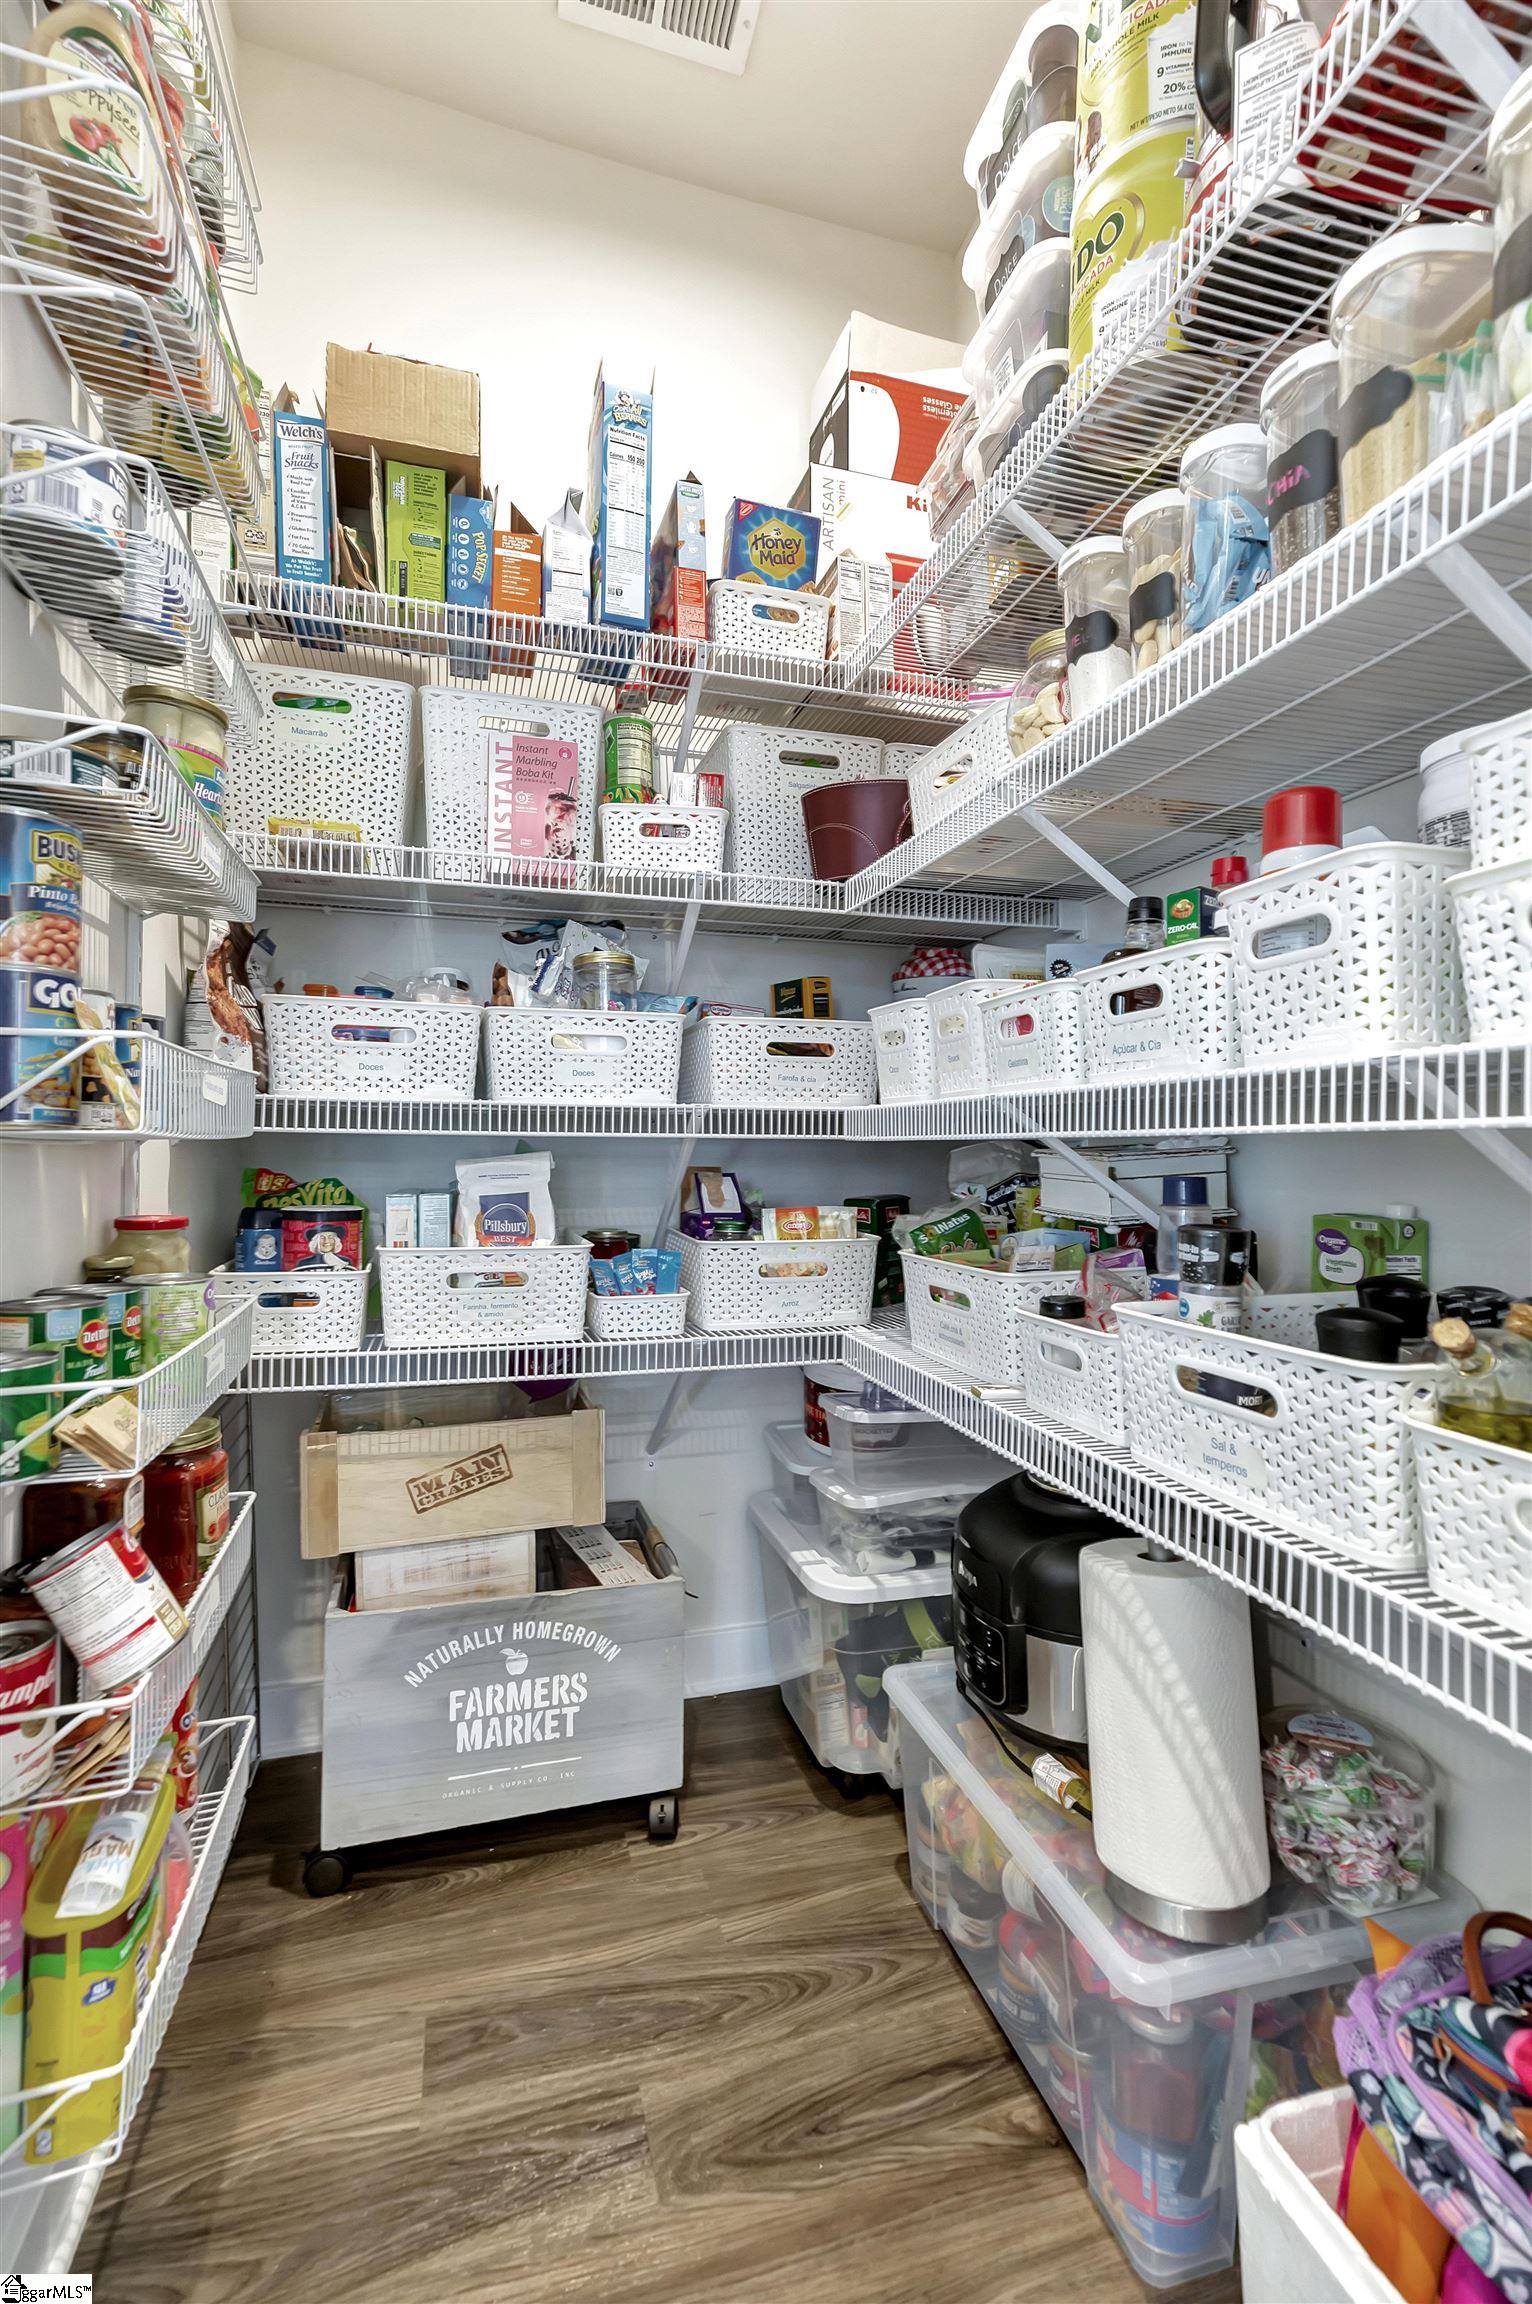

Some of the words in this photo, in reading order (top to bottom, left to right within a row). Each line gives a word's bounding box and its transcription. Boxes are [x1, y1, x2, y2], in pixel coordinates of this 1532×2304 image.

[1136, 11, 1160, 30] MILK
[1160, 42, 1178, 52] IRON
[1161, 47, 1192, 59] IMMUNE
[1156, 67, 1165, 78] 9
[1163, 81, 1186, 95] 20%
[279, 424, 323, 440] Welch's
[609, 426, 632, 437] Nutrition
[632, 431, 646, 442] Facts
[284, 458, 319, 470] Snacks
[291, 451, 315, 461] Fruit
[837, 480, 846, 505] mini
[822, 476, 836, 552] ARTISAN
[751, 532, 802, 555] Honey
[760, 549, 797, 567] Maid
[291, 725, 329, 738] Macarrão
[516, 743, 549, 755] Instant
[515, 755, 558, 770] Marbling
[515, 766, 541, 779] Boba
[541, 768, 555, 780] Kit
[788, 780, 818, 790] Salgadinh
[493, 741, 513, 853] INSTANT
[27, 885, 69, 902] Pinto
[1112, 1043, 1138, 1057] Açúcar
[1139, 1041, 1146, 1051] &
[1147, 1039, 1162, 1051] Cia
[358, 1062, 385, 1072] Doces
[572, 1069, 596, 1077] Doces
[777, 1073, 799, 1083] Farofa
[484, 1218, 528, 1234] Pillsbury
[494, 1234, 518, 1243] BEST
[781, 1300, 800, 1308] Arroz
[1211, 1437, 1227, 1453] Sal
[1229, 1443, 1238, 1457] &
[1202, 1452, 1249, 1479] temperos
[413, 1451, 501, 1498] MAN
[418, 1466, 506, 1507] CRATES
[403, 1624, 505, 1688] NATURALLY
[512, 1620, 623, 1664] HOMEGROWN
[449, 1672, 588, 1722] FARMERS
[456, 1705, 582, 1754] MARKET
[441, 1786, 482, 1800] ORGANIC
[500, 1778, 534, 1789] SUPPLY
